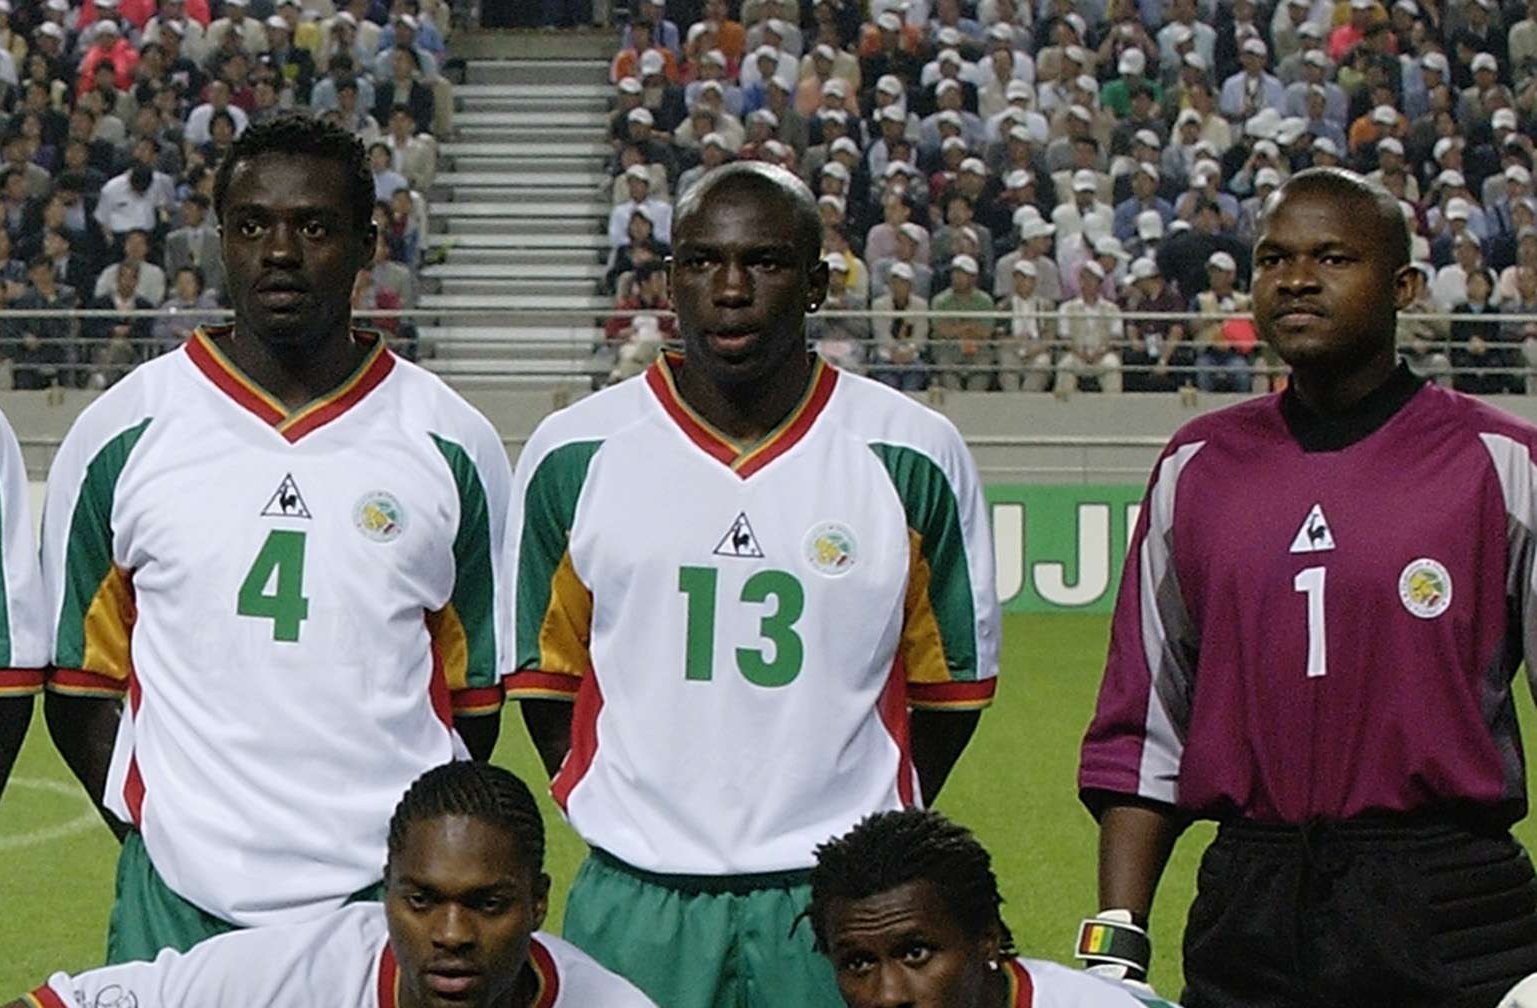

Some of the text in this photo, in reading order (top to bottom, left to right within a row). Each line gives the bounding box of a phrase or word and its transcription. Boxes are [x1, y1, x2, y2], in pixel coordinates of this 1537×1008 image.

[236, 529, 309, 642] 4
[678, 565, 805, 687] 13
[1293, 566, 1327, 678] 1
